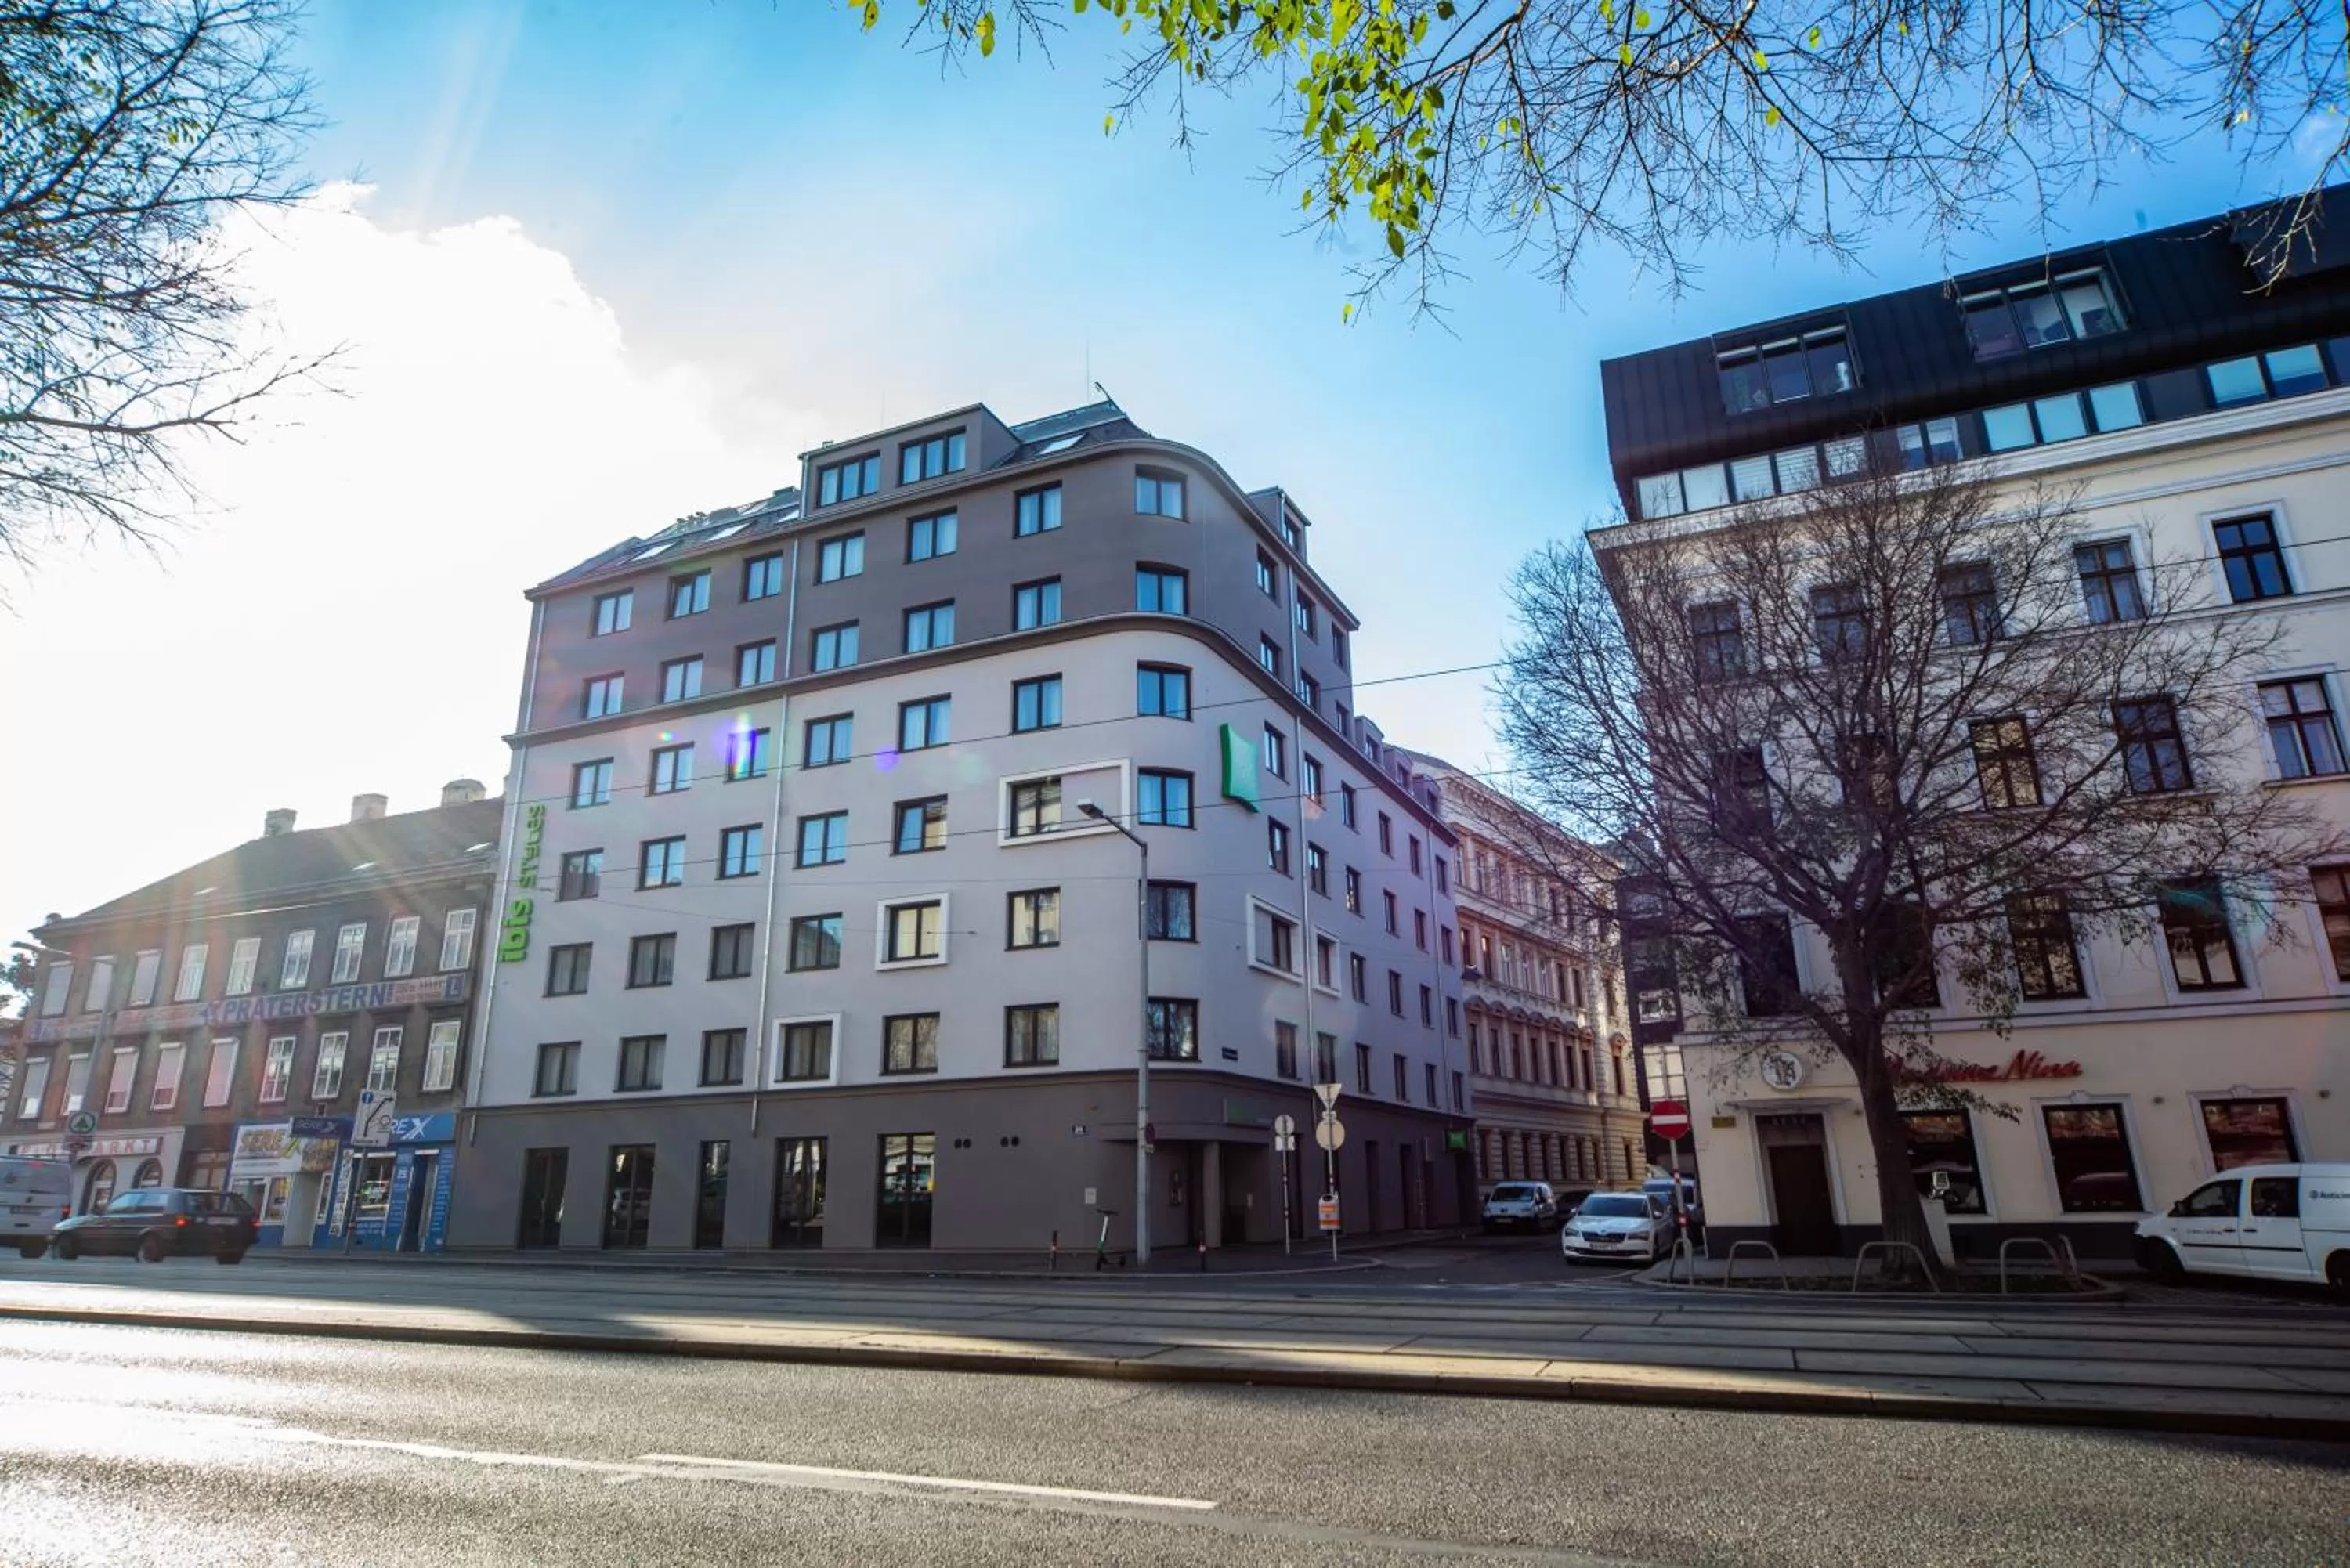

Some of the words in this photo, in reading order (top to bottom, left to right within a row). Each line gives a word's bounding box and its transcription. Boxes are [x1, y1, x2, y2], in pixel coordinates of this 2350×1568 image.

[497, 898, 533, 963] ibis
[223, 984, 386, 1024] PRATERSTERN
[390, 1115, 436, 1141] REX
